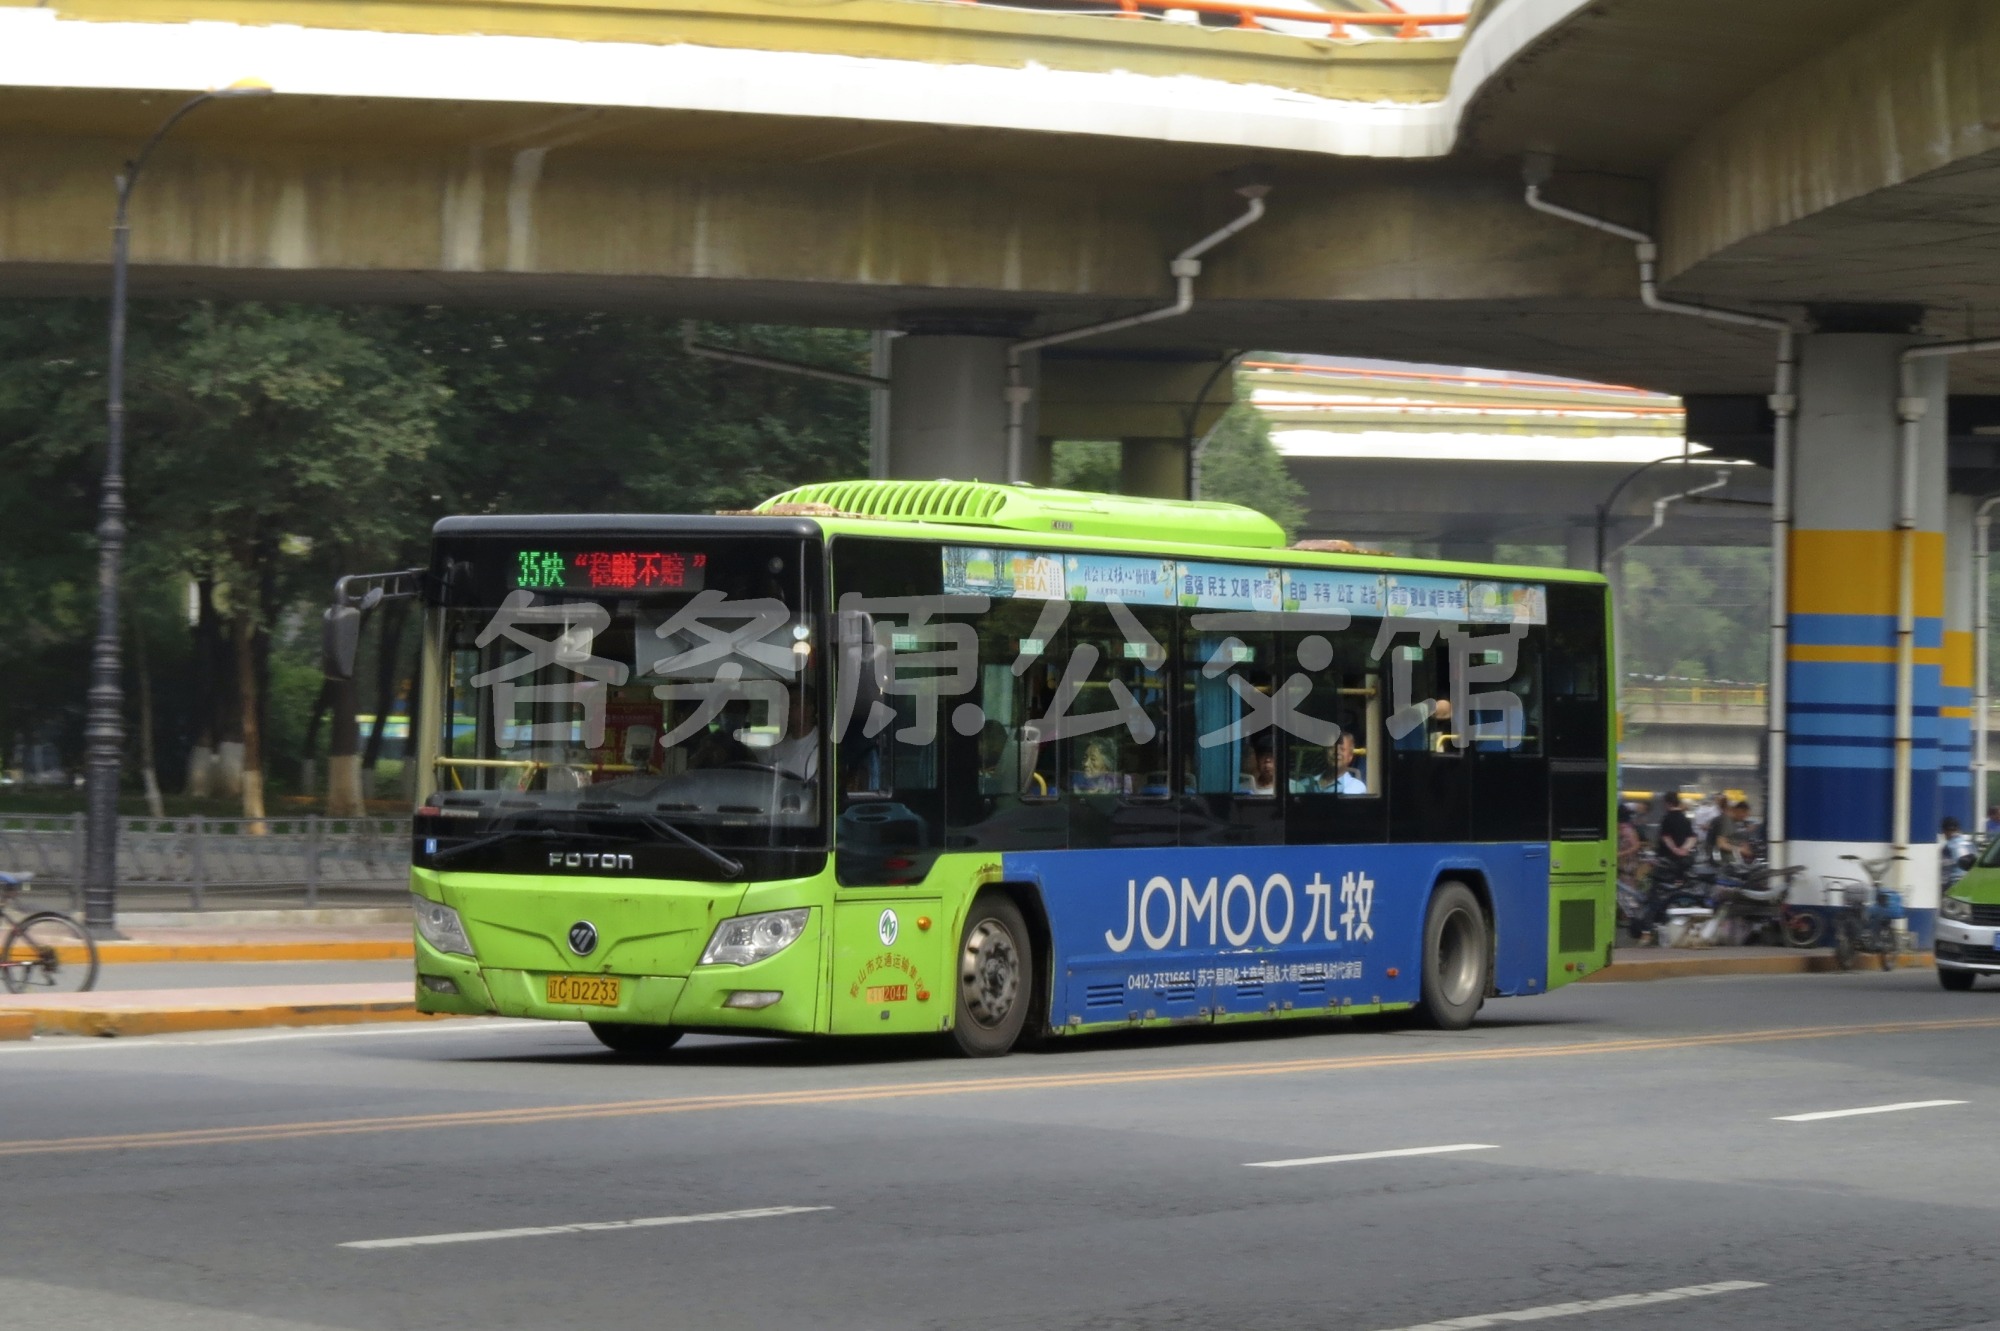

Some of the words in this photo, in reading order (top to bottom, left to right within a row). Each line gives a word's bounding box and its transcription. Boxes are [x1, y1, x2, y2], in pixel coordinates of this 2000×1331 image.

[517, 551, 566, 587] 35快
[1184, 575, 1204, 595] 富强
[1208, 576, 1227, 597] 民主
[1231, 578, 1250, 598] 文明
[1253, 579, 1273, 600] 和谐
[1290, 582, 1307, 601] 自由
[1313, 583, 1331, 603] 平等
[1337, 584, 1354, 604] 公正
[1360, 585, 1377, 605] 法治
[549, 852, 634, 870] FOTON
[1105, 873, 1294, 953] JOMOO
[1302, 871, 1375, 942] 九牧
